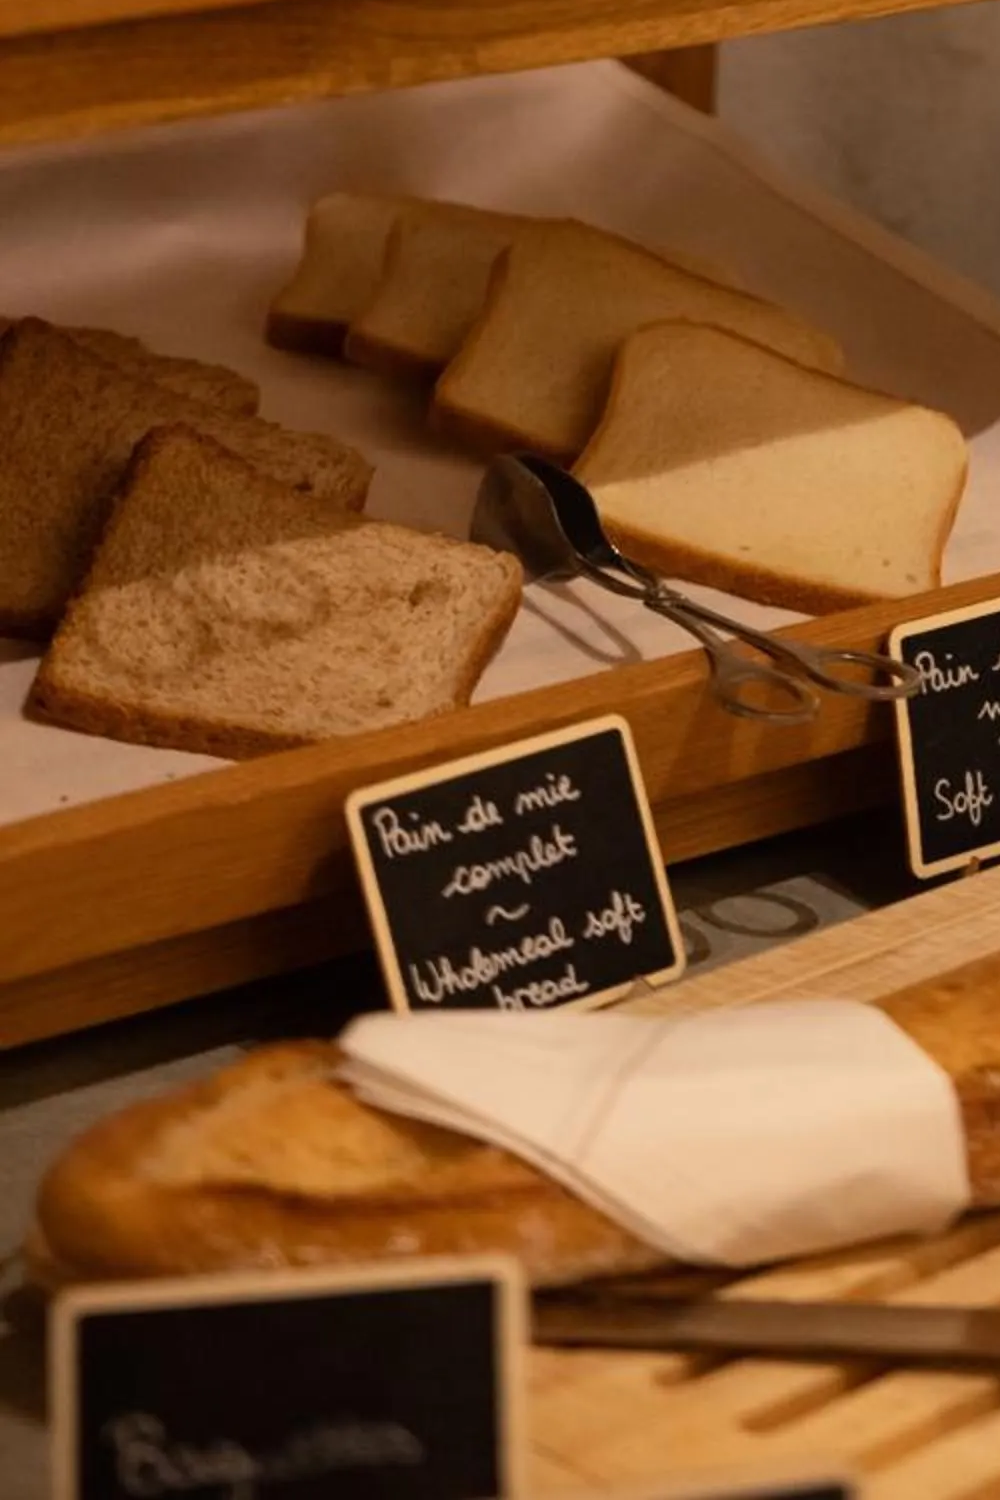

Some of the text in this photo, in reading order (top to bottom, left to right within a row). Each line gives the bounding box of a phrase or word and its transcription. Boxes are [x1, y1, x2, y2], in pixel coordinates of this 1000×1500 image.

[915, 651, 979, 694] Pain
[373, 773, 581, 858] Pain de mie
[935, 771, 993, 826] Soft
[442, 824, 578, 898] complet
[409, 891, 646, 1002] Wholemeal soft
[493, 964, 590, 1011] bread
